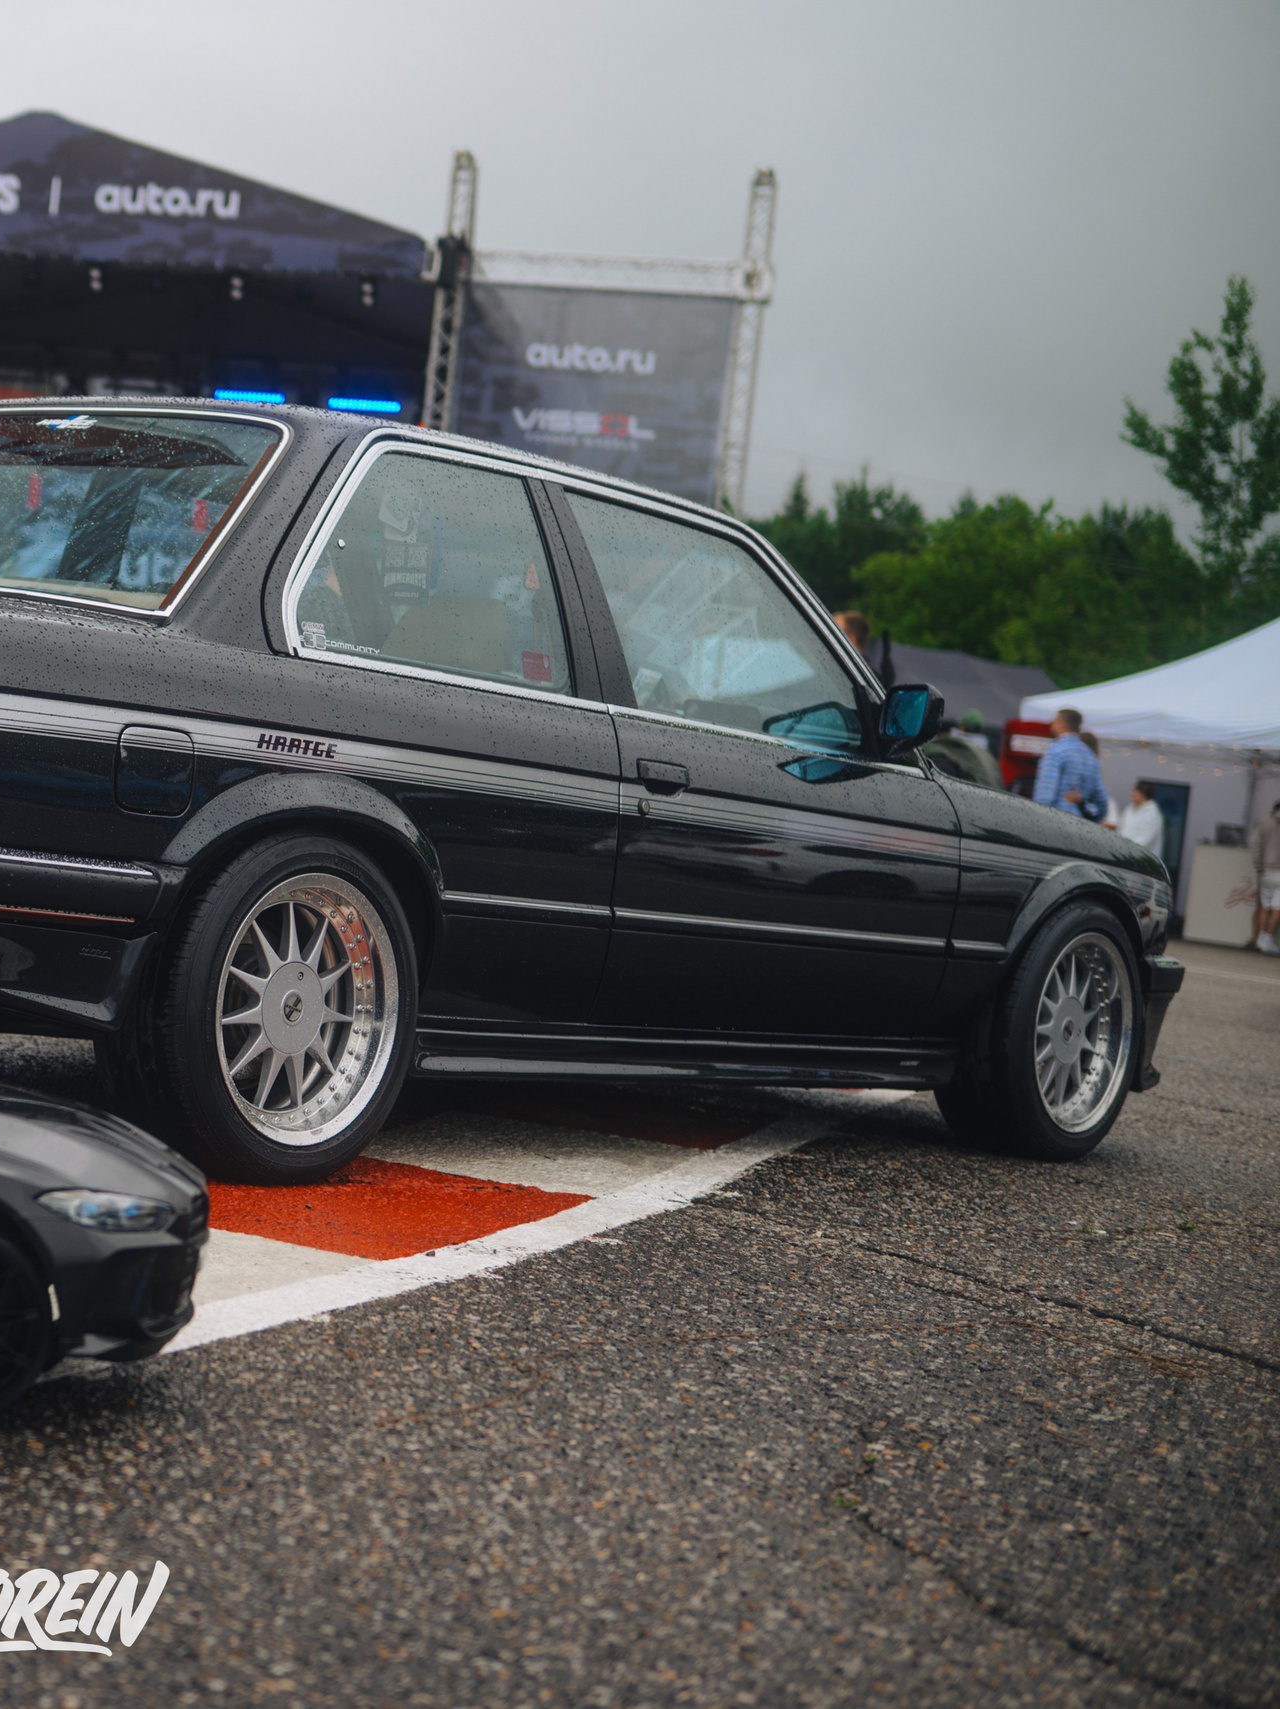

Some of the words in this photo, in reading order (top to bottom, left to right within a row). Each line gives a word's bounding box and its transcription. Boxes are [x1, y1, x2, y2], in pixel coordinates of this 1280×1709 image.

[94, 183, 241, 219] auto.ru
[526, 342, 656, 375] auto.ru
[256, 732, 338, 760] HARTGE
